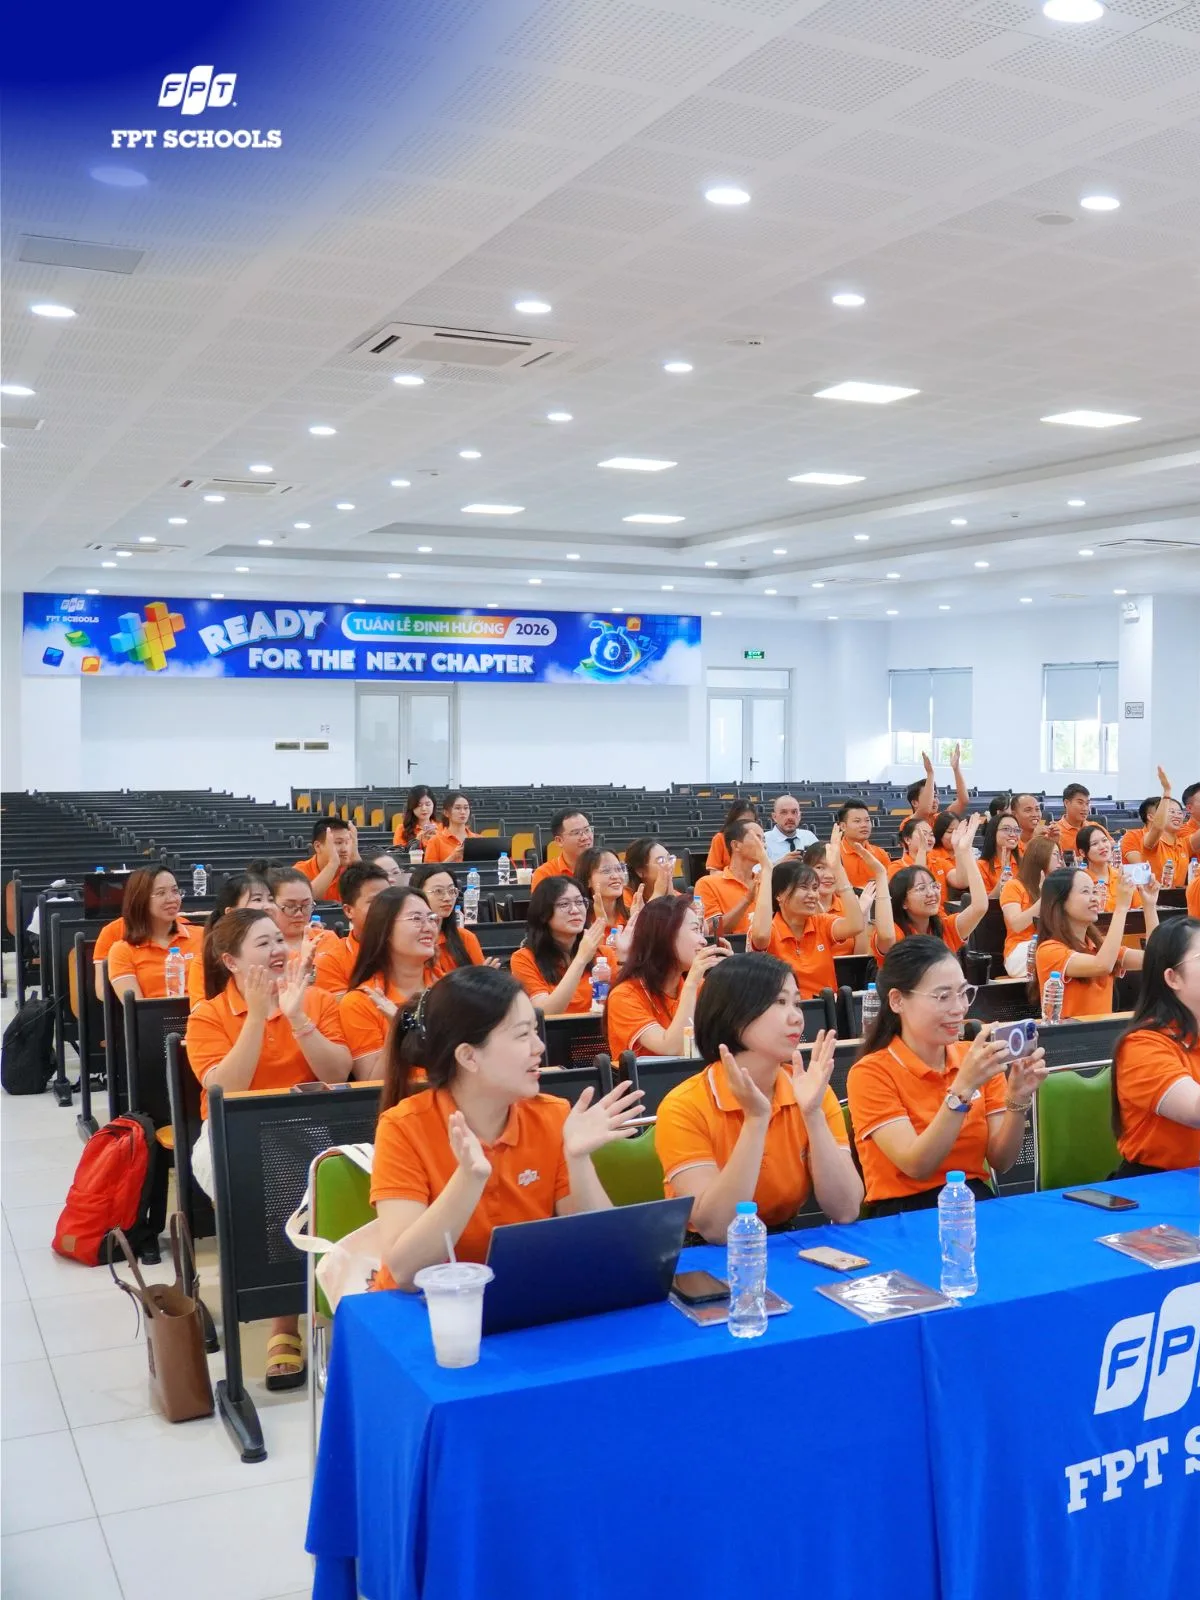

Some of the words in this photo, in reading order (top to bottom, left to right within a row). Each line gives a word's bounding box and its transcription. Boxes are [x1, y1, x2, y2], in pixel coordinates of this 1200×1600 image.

[62, 615, 100, 623] SCHOOLS
[413, 620, 449, 635] ĐỊNH
[516, 623, 549, 636] 2026
[198, 609, 326, 657] READY
[248, 648, 303, 670] FOR
[307, 648, 356, 671] THE
[366, 651, 427, 673] NEXT
[431, 652, 534, 674] CHAPTER
[1064, 1435, 1169, 1514] FPT
